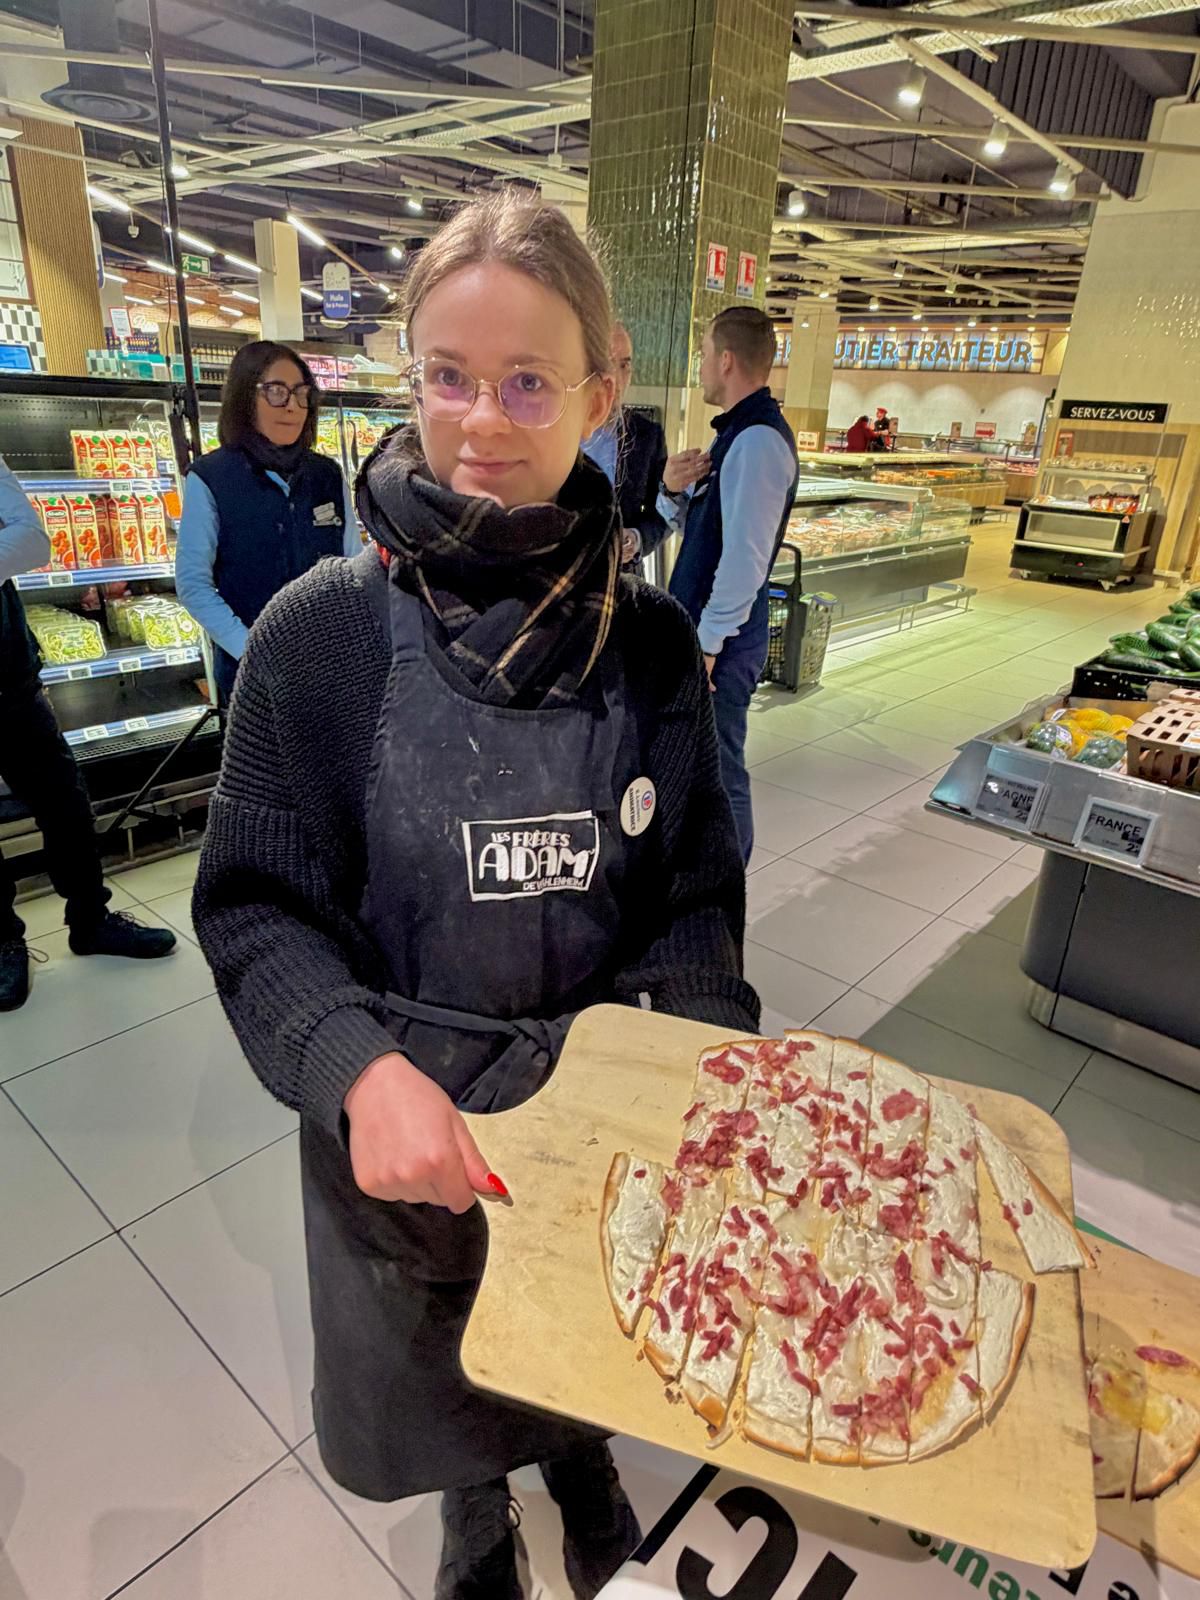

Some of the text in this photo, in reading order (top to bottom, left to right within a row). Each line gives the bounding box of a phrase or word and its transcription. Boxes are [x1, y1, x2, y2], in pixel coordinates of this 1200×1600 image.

[903, 340, 1033, 364] TRAITEUR
[1070, 406, 1156, 421] SERVEZ-VOUS
[1088, 813, 1142, 835] FRANCE
[491, 829, 571, 848] LES FRÈRES
[478, 843, 595, 882] ADAM
